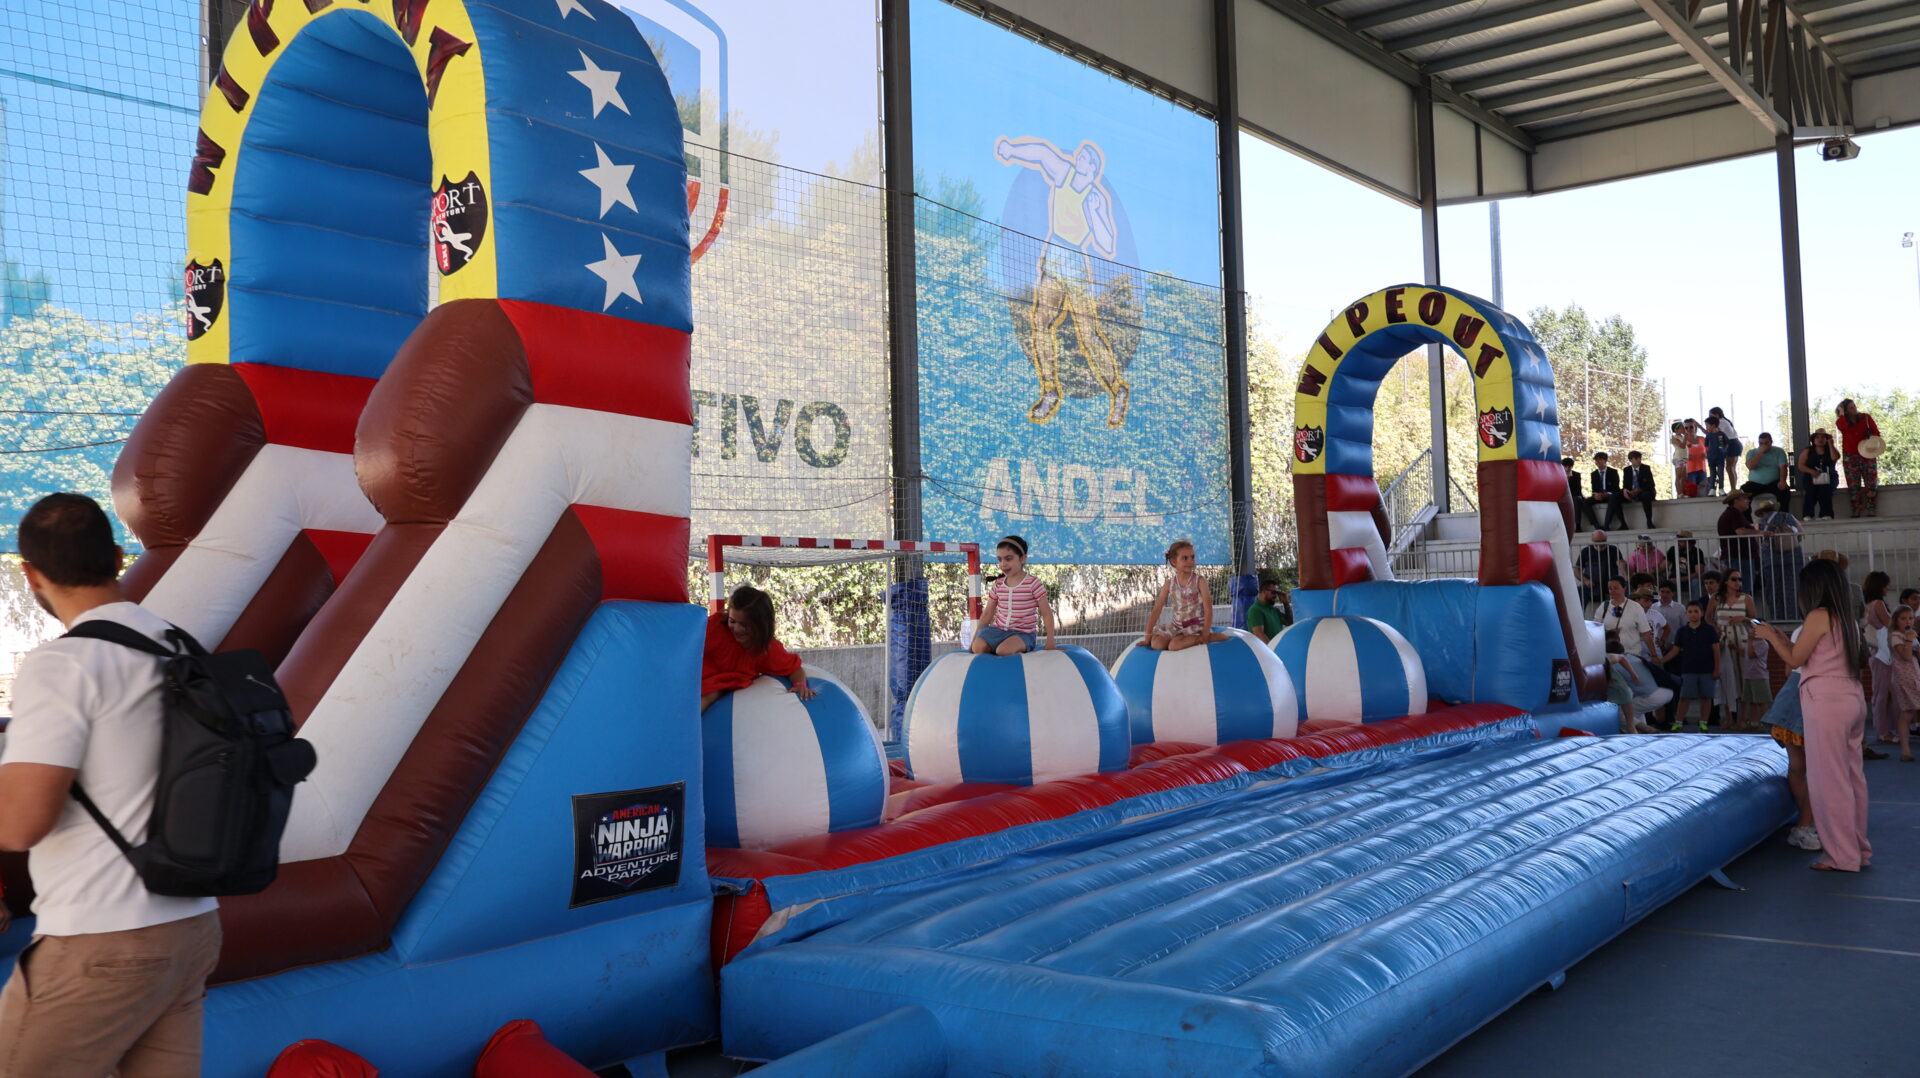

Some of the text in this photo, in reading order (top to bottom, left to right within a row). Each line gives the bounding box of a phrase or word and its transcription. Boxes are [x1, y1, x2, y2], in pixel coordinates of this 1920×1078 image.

[1297, 287, 1505, 397] WIPEOUT
[1480, 410, 1511, 424] SPORT
[978, 456, 1164, 527] ANDEL
[611, 804, 660, 820] AMERICAN
[597, 814, 669, 845] NINJA
[598, 834, 668, 863] WARRIOR
[580, 851, 679, 879] ADVENTURE
[607, 865, 652, 882] PARK
